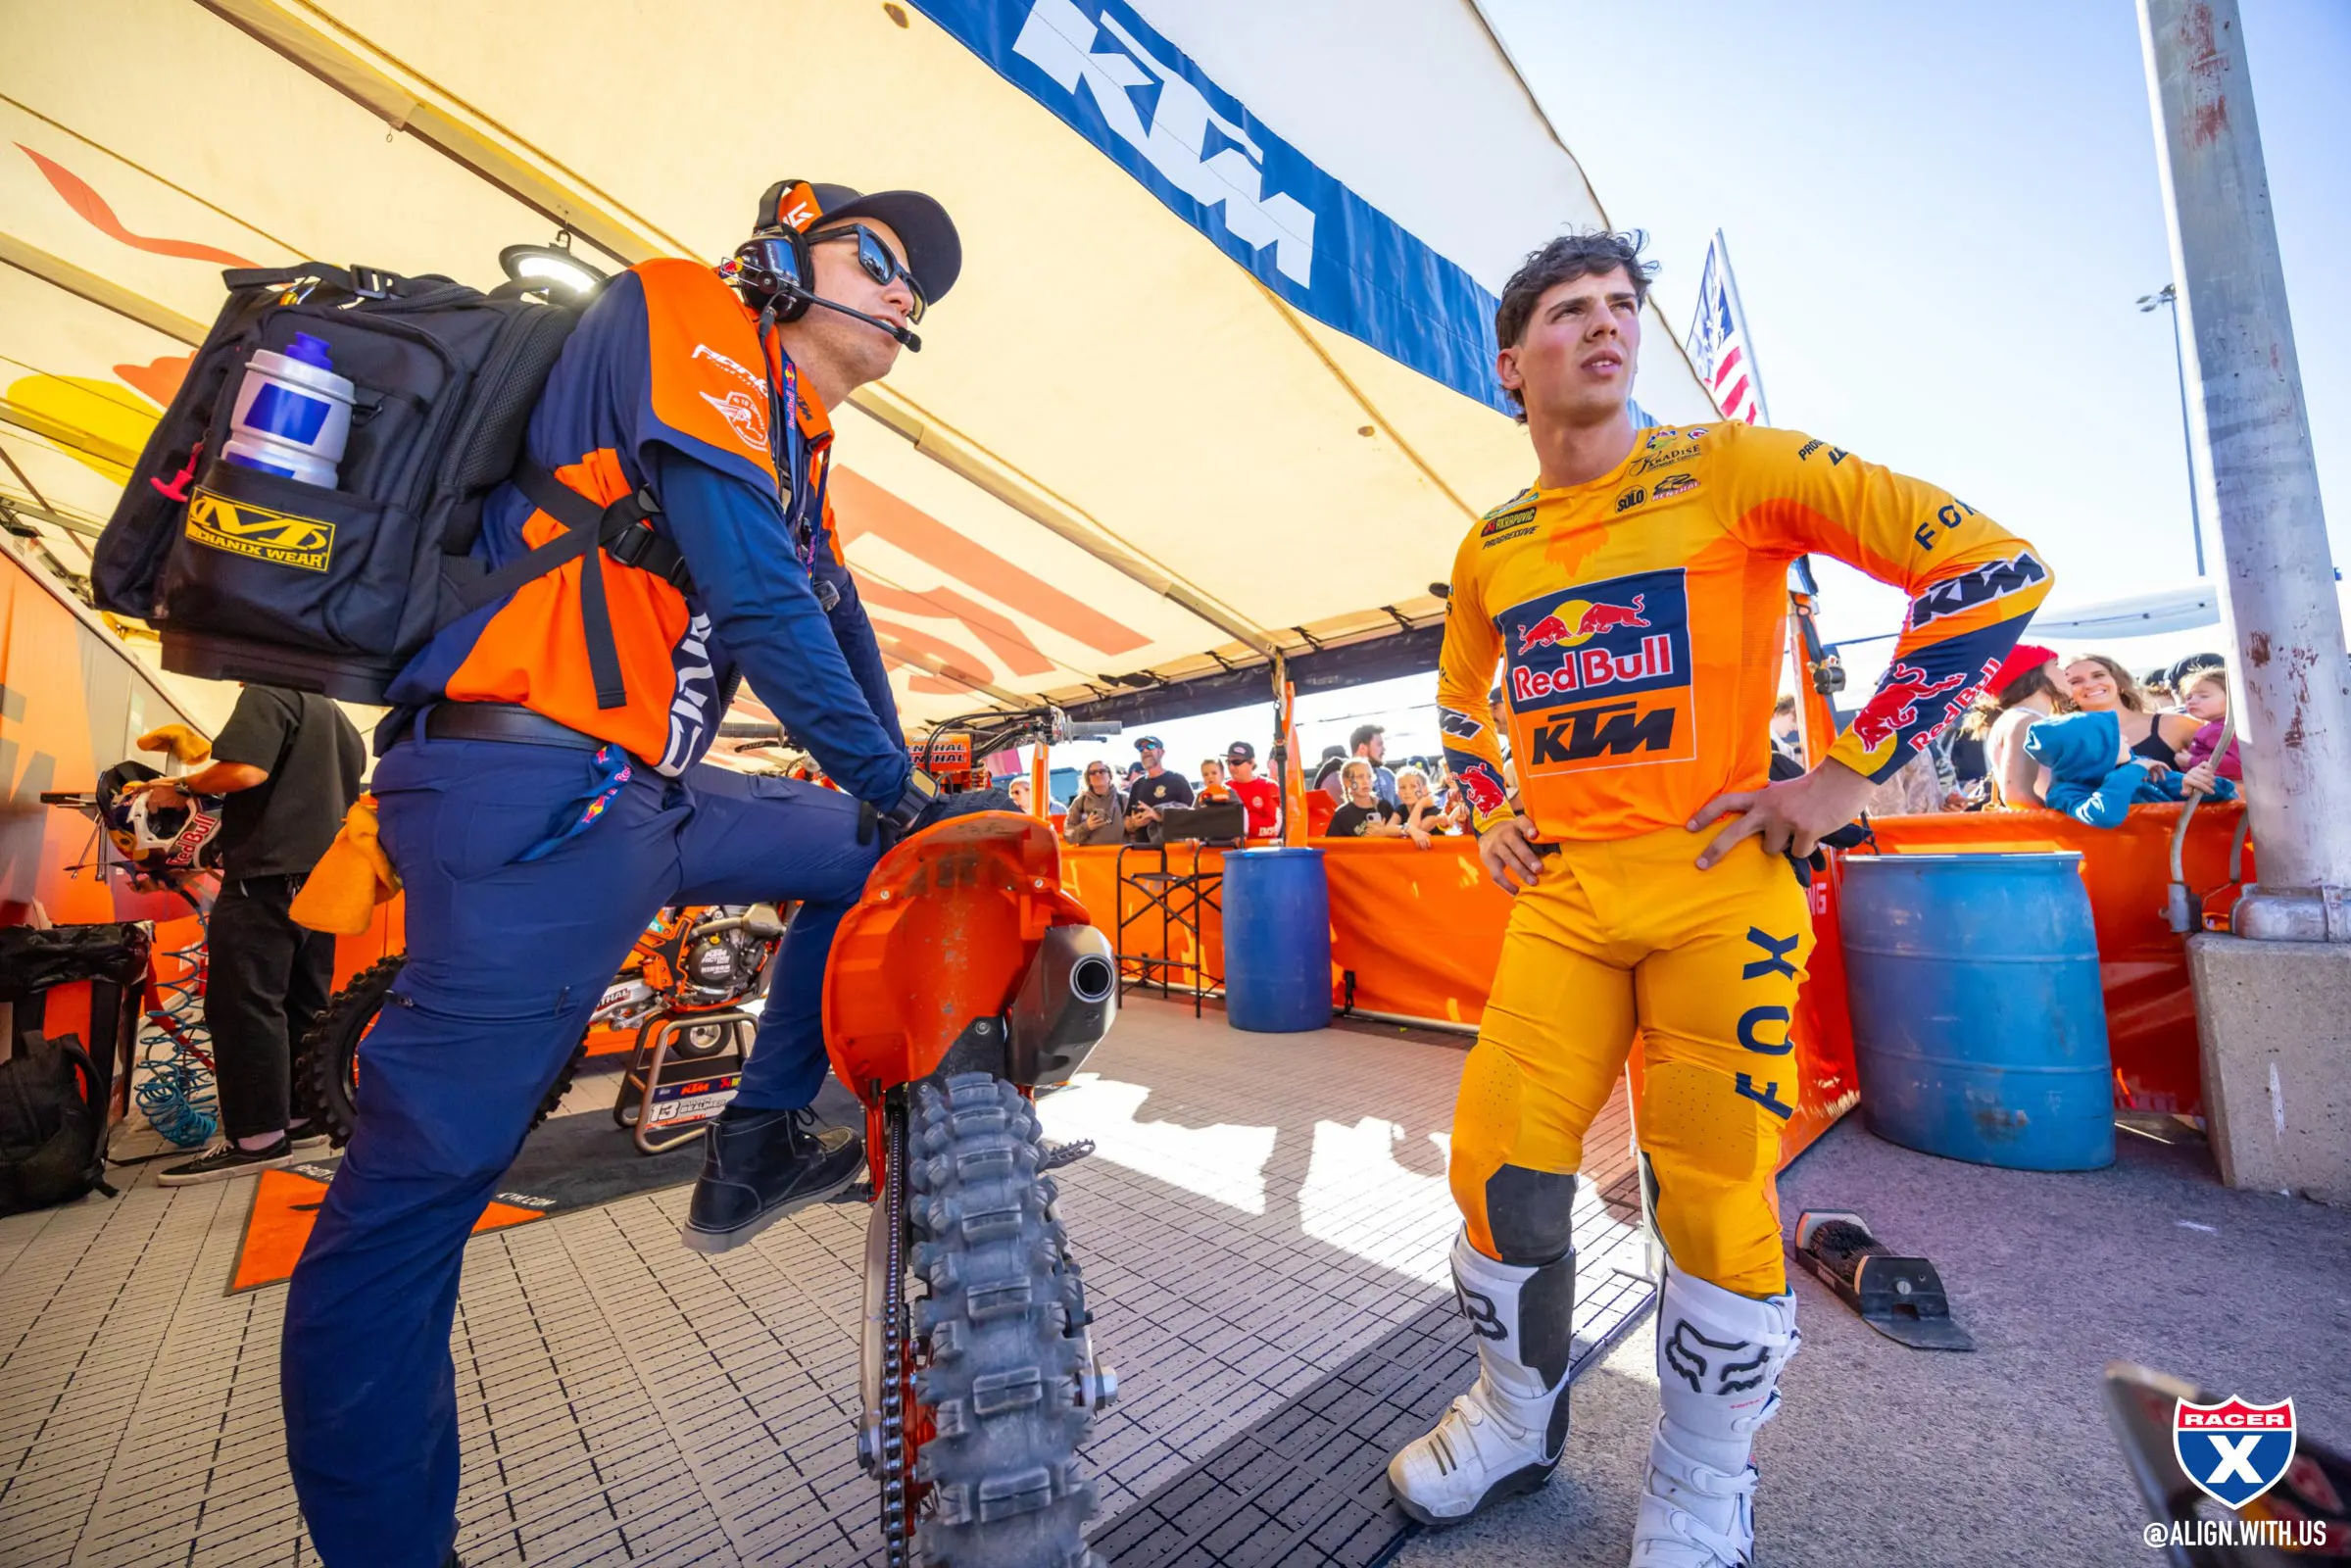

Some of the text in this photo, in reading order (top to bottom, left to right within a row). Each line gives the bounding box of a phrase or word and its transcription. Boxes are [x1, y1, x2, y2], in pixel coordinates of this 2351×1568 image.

[1013, 0, 1315, 289] KTM
[267, 548, 323, 568] WEAR
[1911, 552, 2047, 630] KTM
[1513, 633, 1673, 702] Red Bull
[1532, 701, 1676, 765] KTM
[1909, 658, 2002, 752] Red Bull
[180, 812, 218, 844] Bull
[1735, 926, 1799, 1120] FOX
[651, 1101, 680, 1122] 13
